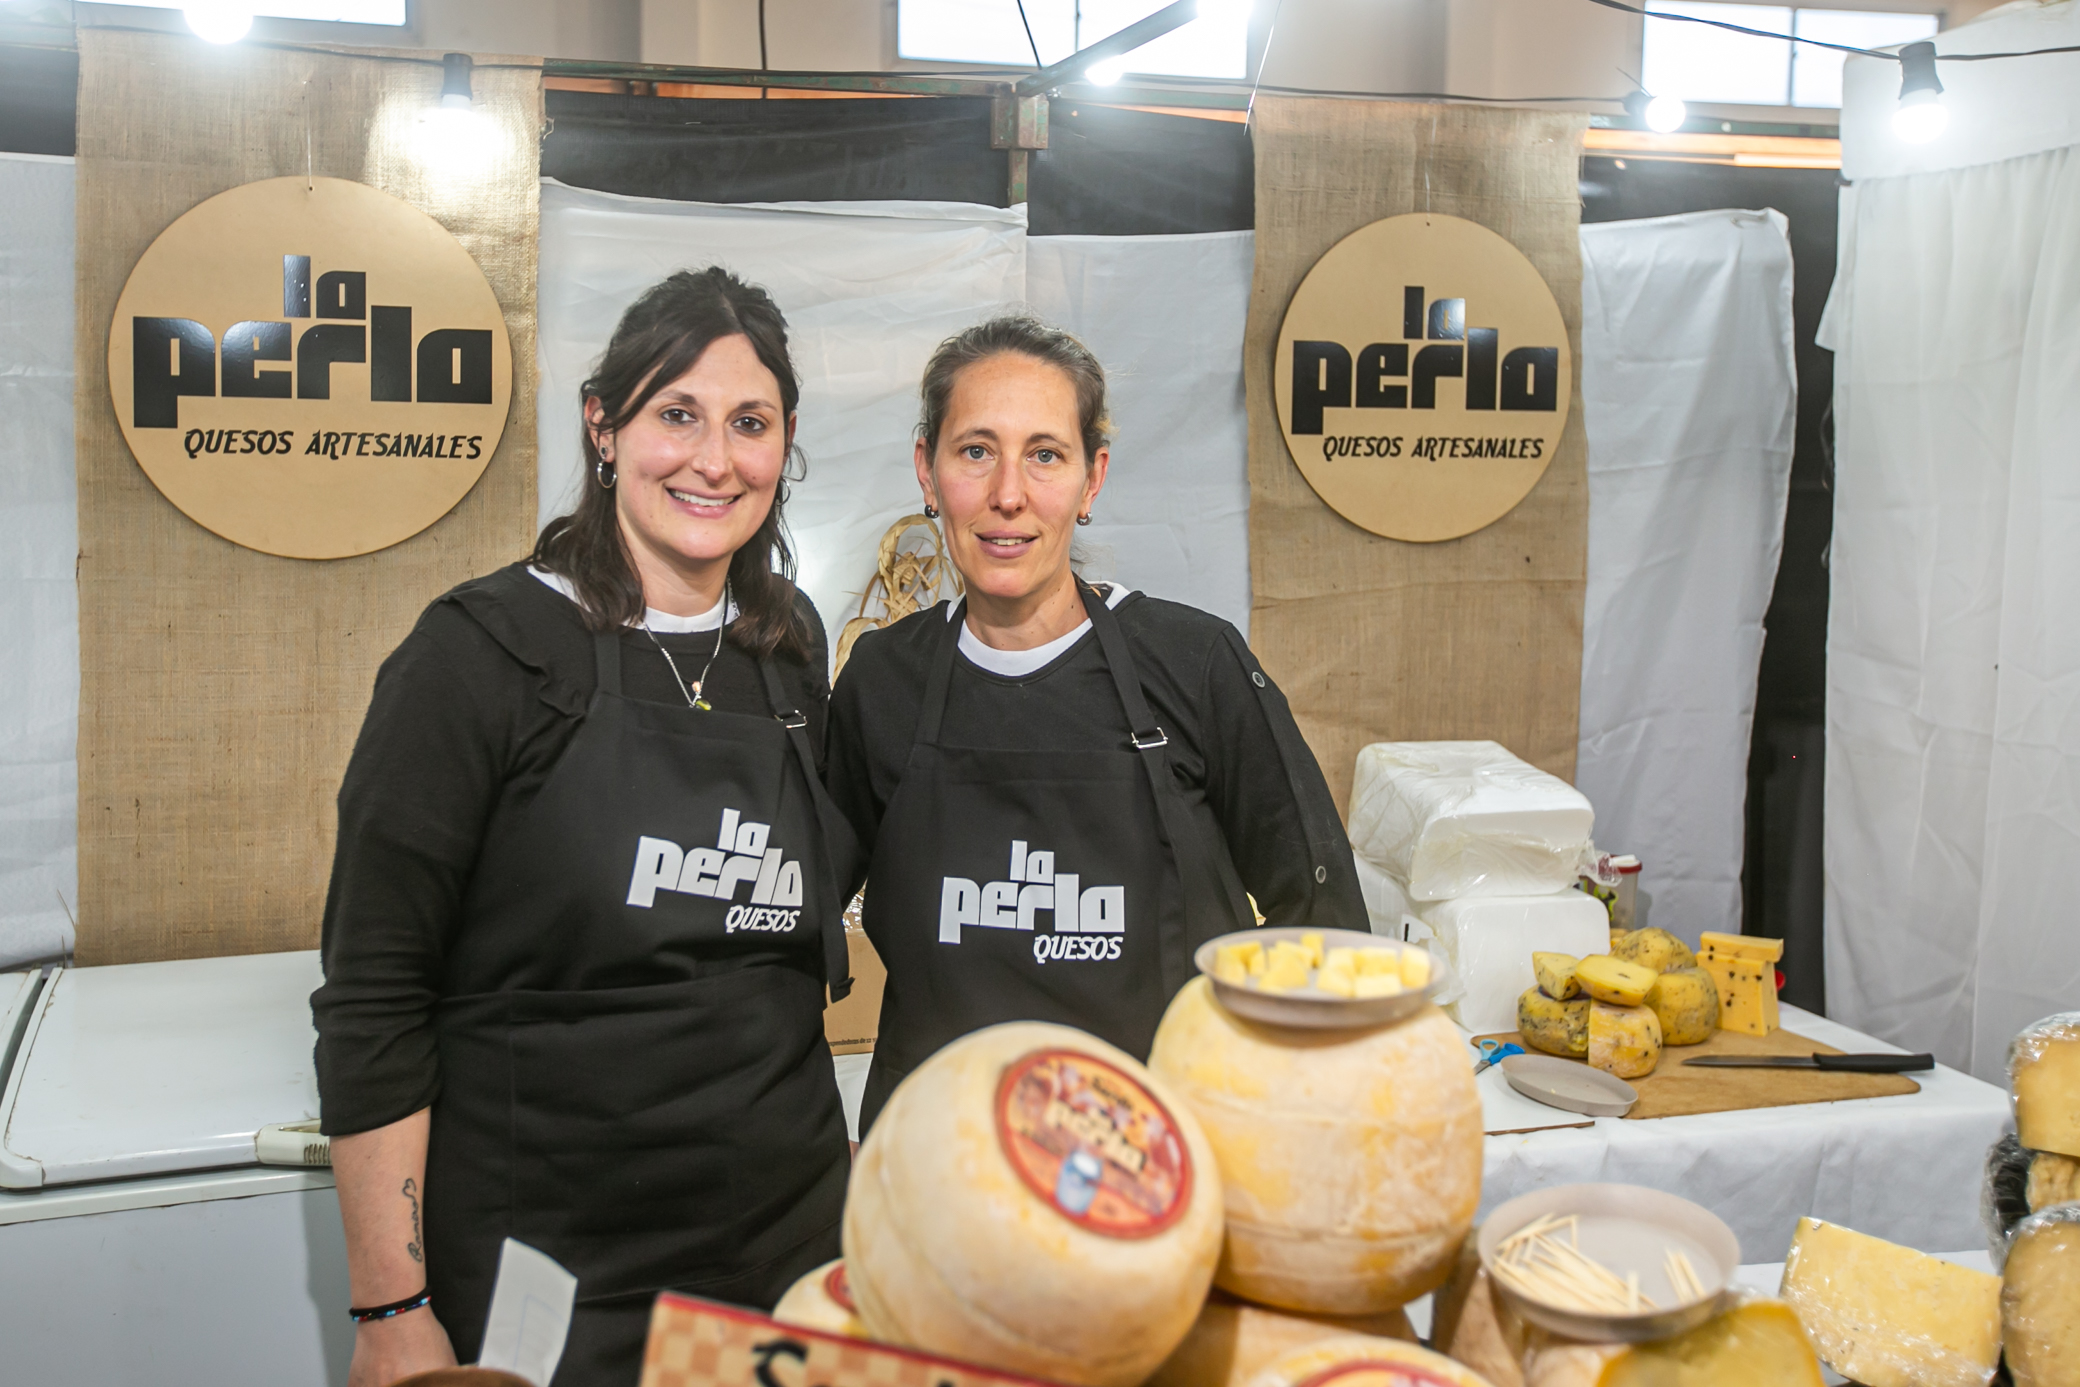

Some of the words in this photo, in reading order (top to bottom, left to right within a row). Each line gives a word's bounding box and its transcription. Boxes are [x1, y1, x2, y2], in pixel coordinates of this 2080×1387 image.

[283, 254, 366, 320] la
[1404, 286, 1465, 340] la
[133, 305, 493, 428] perla
[1291, 327, 1558, 435] perla
[184, 428, 294, 459] QUESOS
[304, 430, 482, 460] ARTESANALES
[1322, 436, 1403, 461] QUESOS
[1411, 435, 1544, 461] ARTESANALES
[717, 808, 770, 857] la
[626, 836, 803, 908] perla
[1010, 840, 1054, 884] la
[725, 904, 800, 933] QUESOS
[939, 873, 1125, 944] perla
[1033, 934, 1123, 964] QUESOS
